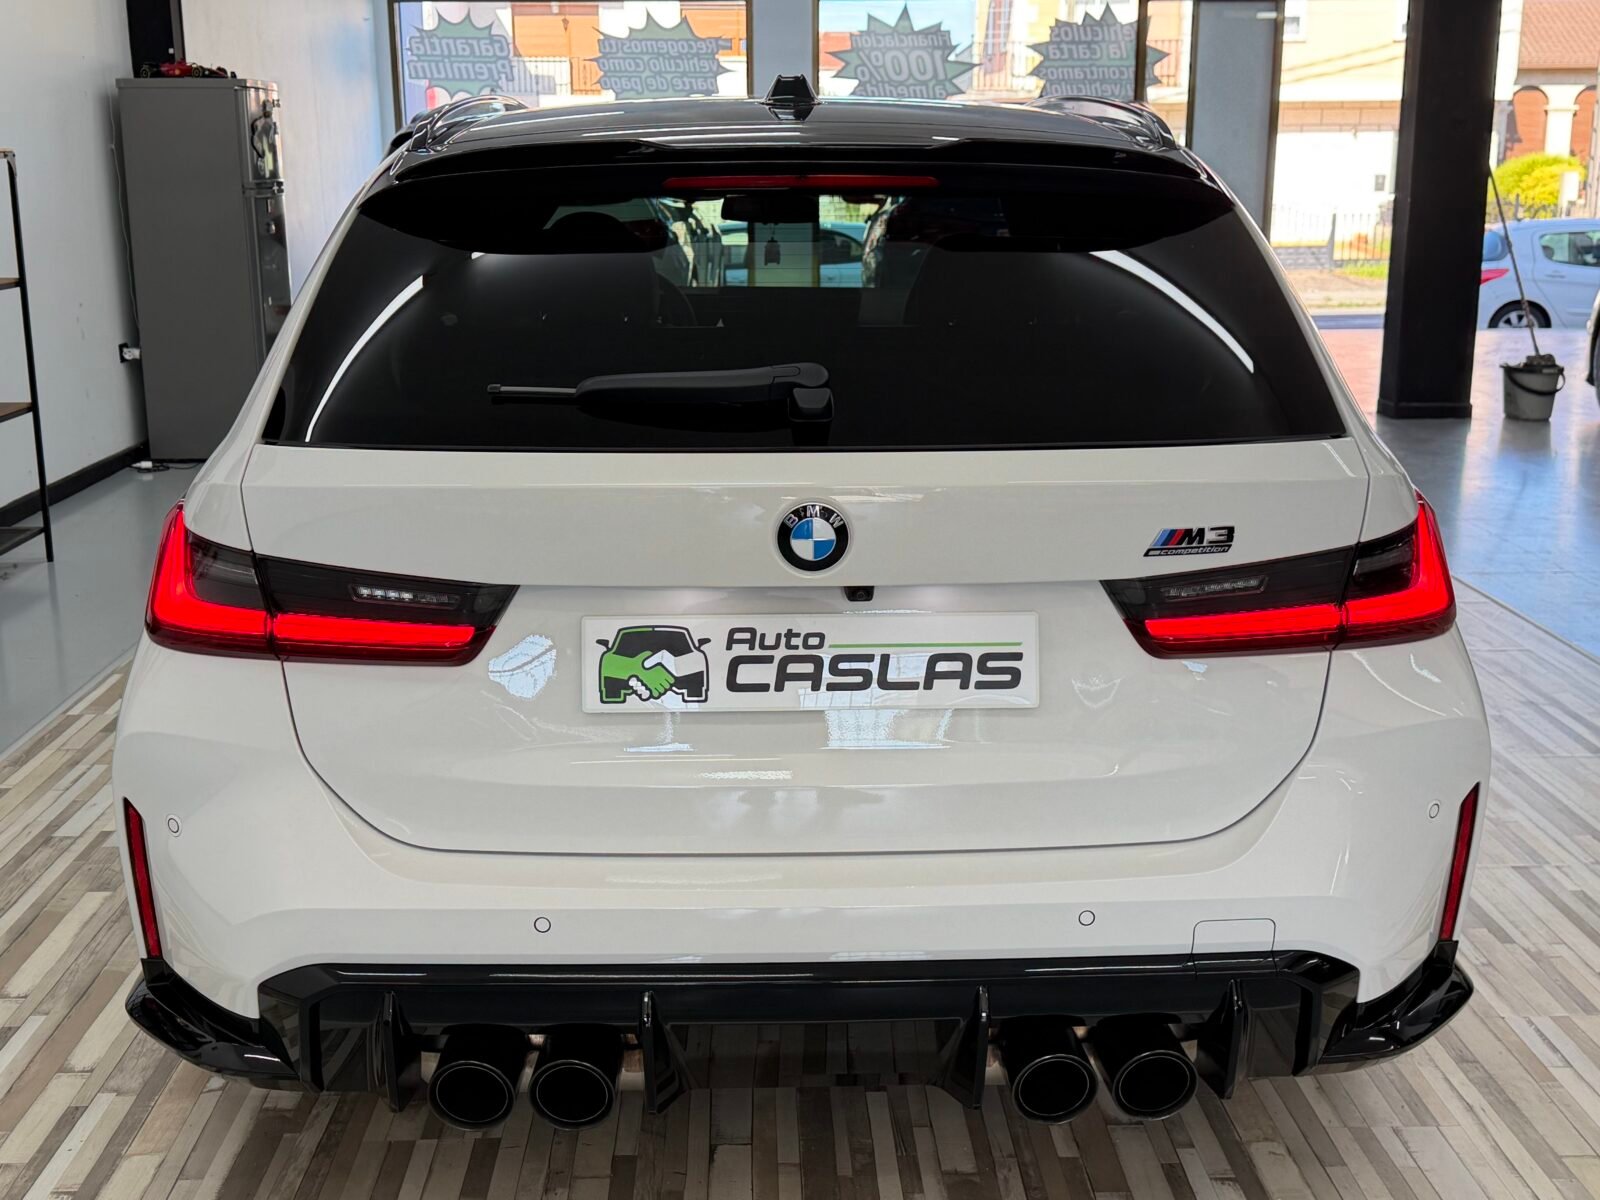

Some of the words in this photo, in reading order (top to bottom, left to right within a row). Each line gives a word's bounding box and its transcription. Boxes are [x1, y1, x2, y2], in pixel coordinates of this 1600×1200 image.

[784, 505, 844, 529] BMW
[1176, 526, 1235, 545] M3
[1160, 545, 1230, 556] competition
[725, 627, 826, 651] Auto
[725, 652, 1024, 692] CASLAS
